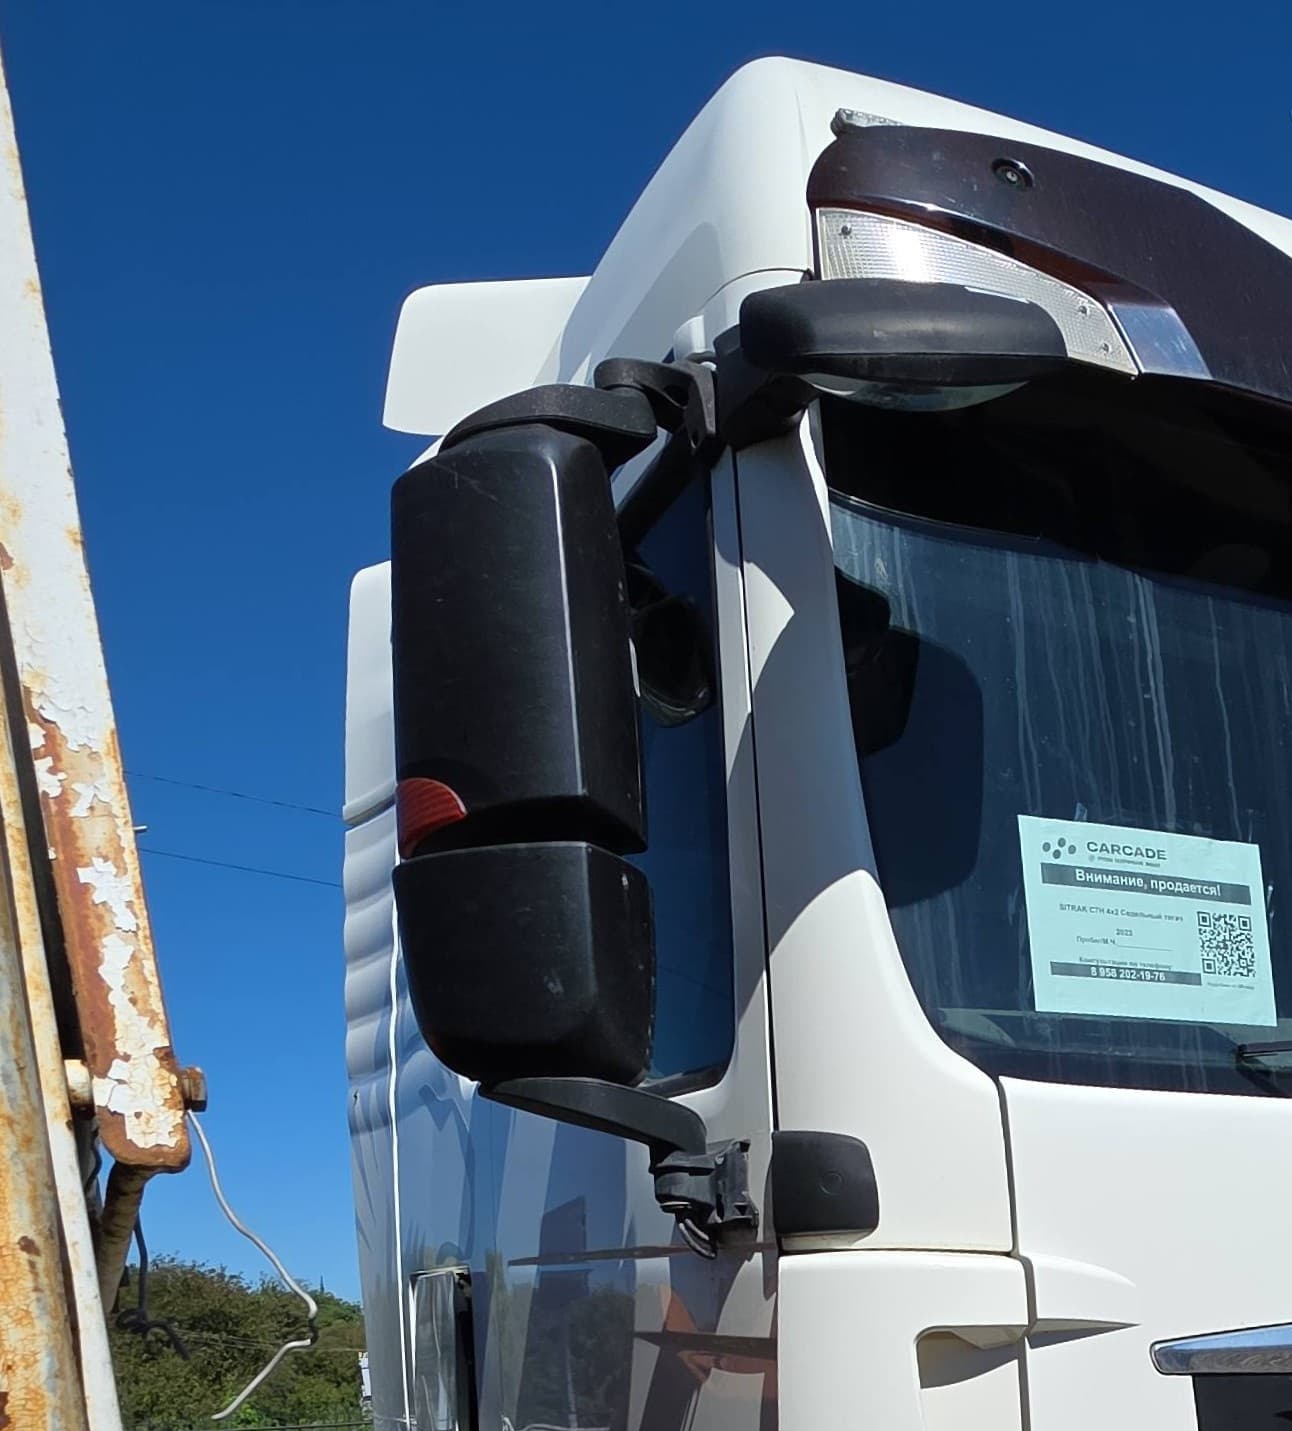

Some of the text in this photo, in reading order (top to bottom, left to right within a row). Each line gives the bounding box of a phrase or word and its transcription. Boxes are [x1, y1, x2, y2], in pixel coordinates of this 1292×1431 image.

[1086, 840, 1168, 861] CARCADE
[1075, 868, 1222, 897] Внимание, продается!
[1059, 903, 1088, 913] SITRAK
[1090, 966, 1097, 976] 8
[1098, 967, 1117, 978] 958
